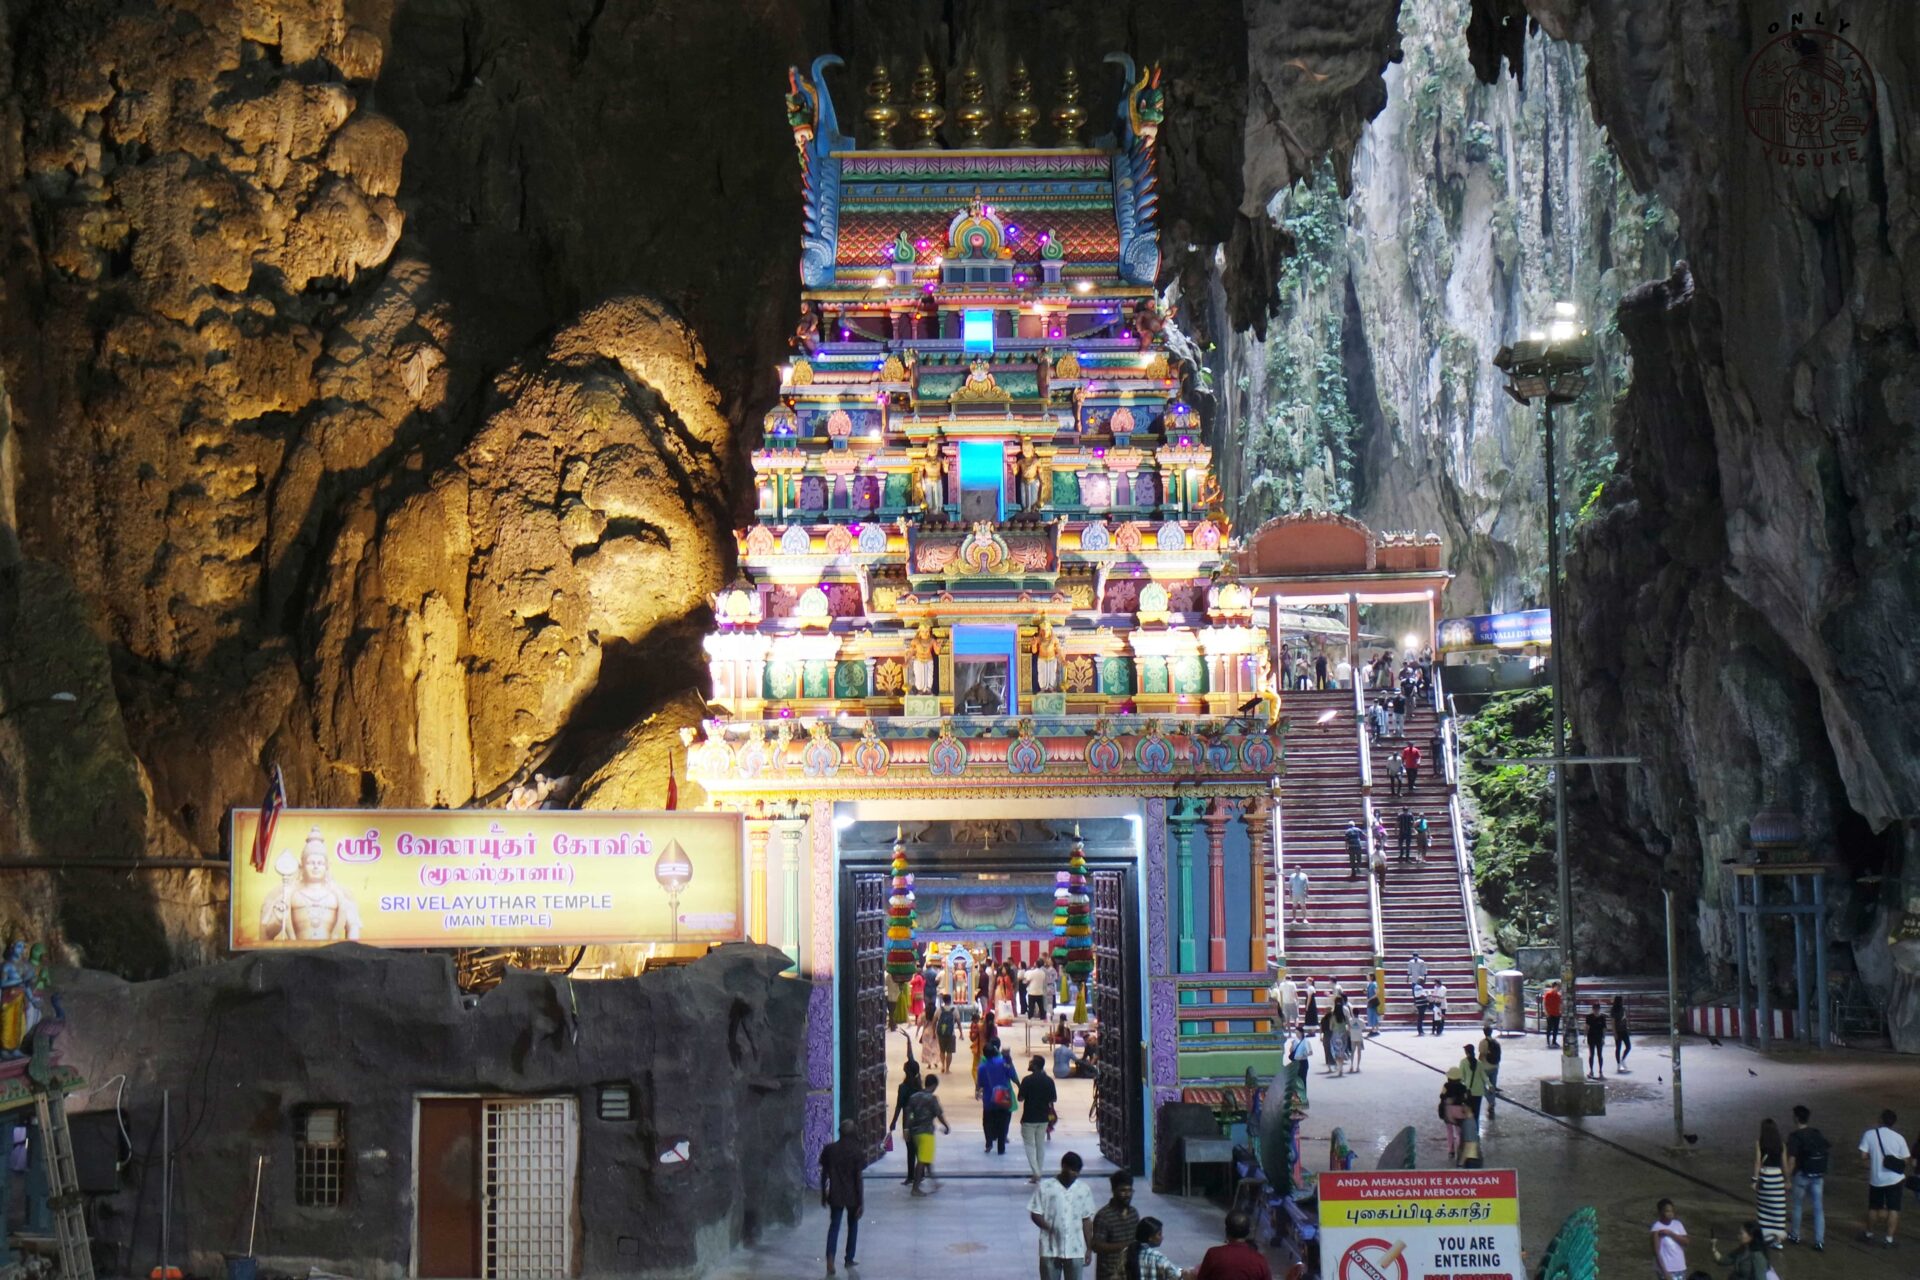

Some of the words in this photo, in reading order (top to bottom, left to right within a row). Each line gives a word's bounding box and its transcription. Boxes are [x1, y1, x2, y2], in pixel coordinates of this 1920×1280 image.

[381, 896, 411, 910] SRI
[416, 896, 537, 910] VELAYUTHAR
[542, 895, 612, 909] TEMPLE
[444, 915, 485, 928] (MAIN
[491, 914, 552, 928] TEMPLE)
[1337, 1178, 1368, 1187] ANDA
[1371, 1178, 1427, 1187] MEMASUKI
[1430, 1177, 1443, 1186] KE
[1445, 1176, 1499, 1186] KAWASAN
[1360, 1189, 1420, 1198] LARANGAN
[1424, 1188, 1477, 1197] MEROKOK
[1438, 1237, 1465, 1250] YOU
[1470, 1236, 1495, 1250] ARE
[1349, 1250, 1363, 1263] NO
[1435, 1253, 1501, 1268] ENTERING
